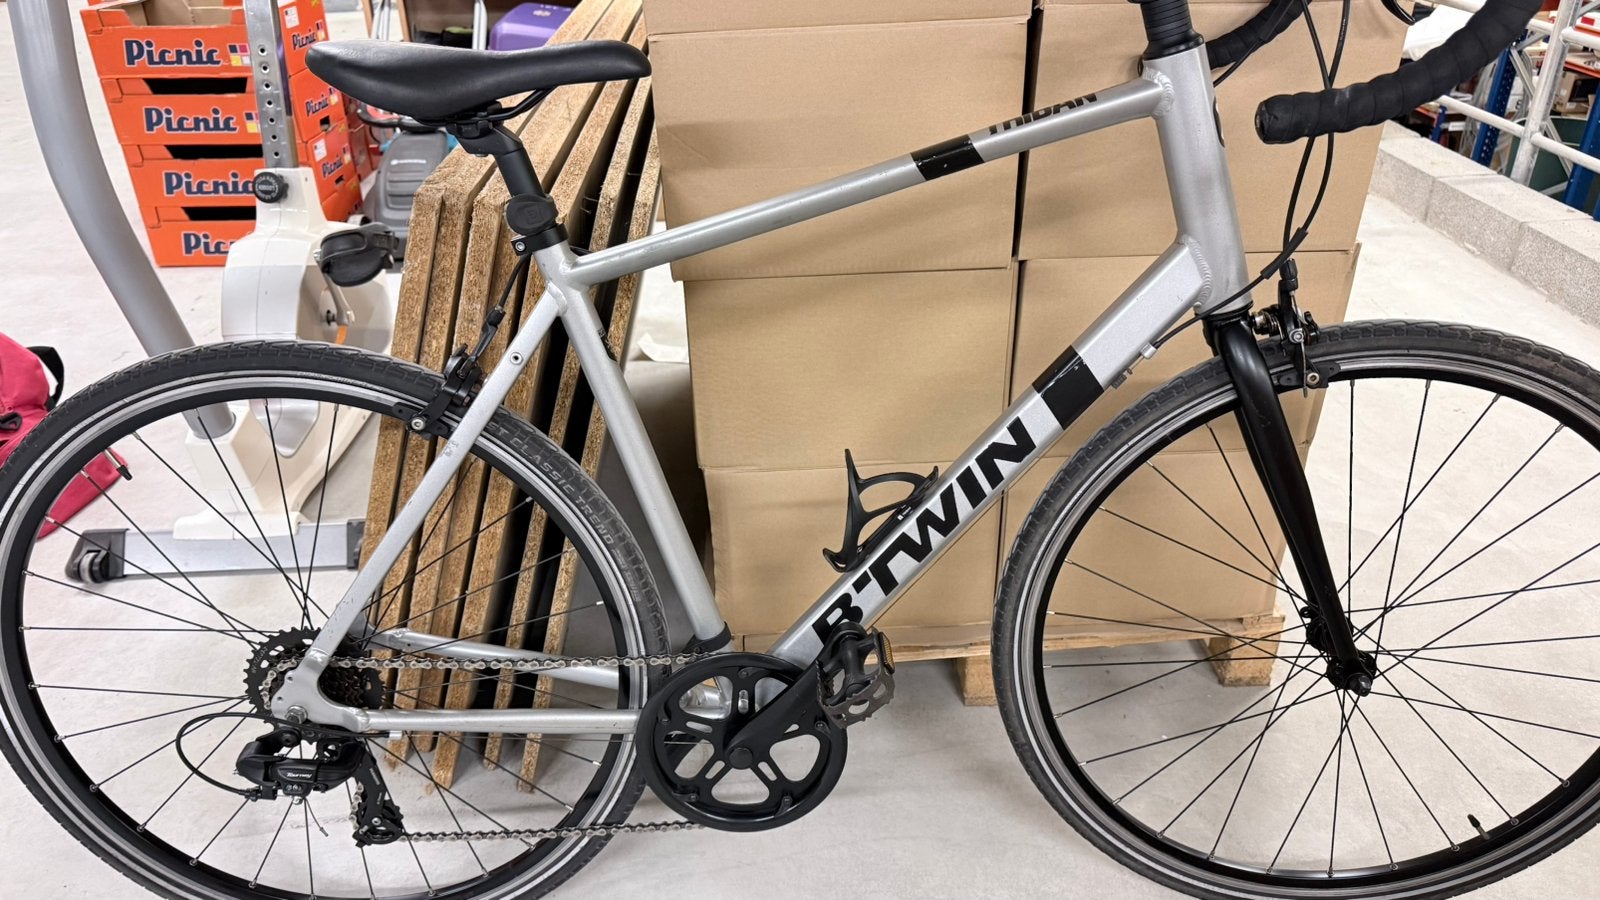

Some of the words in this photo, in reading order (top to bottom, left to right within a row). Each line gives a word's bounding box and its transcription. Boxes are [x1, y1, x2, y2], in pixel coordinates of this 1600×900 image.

[292, 28, 317, 51] Picnic
[123, 39, 222, 67] Picnic
[304, 94, 329, 117] Picnic
[143, 107, 239, 133] Picnic
[321, 154, 344, 178] Picnic
[182, 232, 236, 256] Pic
[509, 437, 576, 495] CLASSIC
[575, 495, 615, 545] TREND
